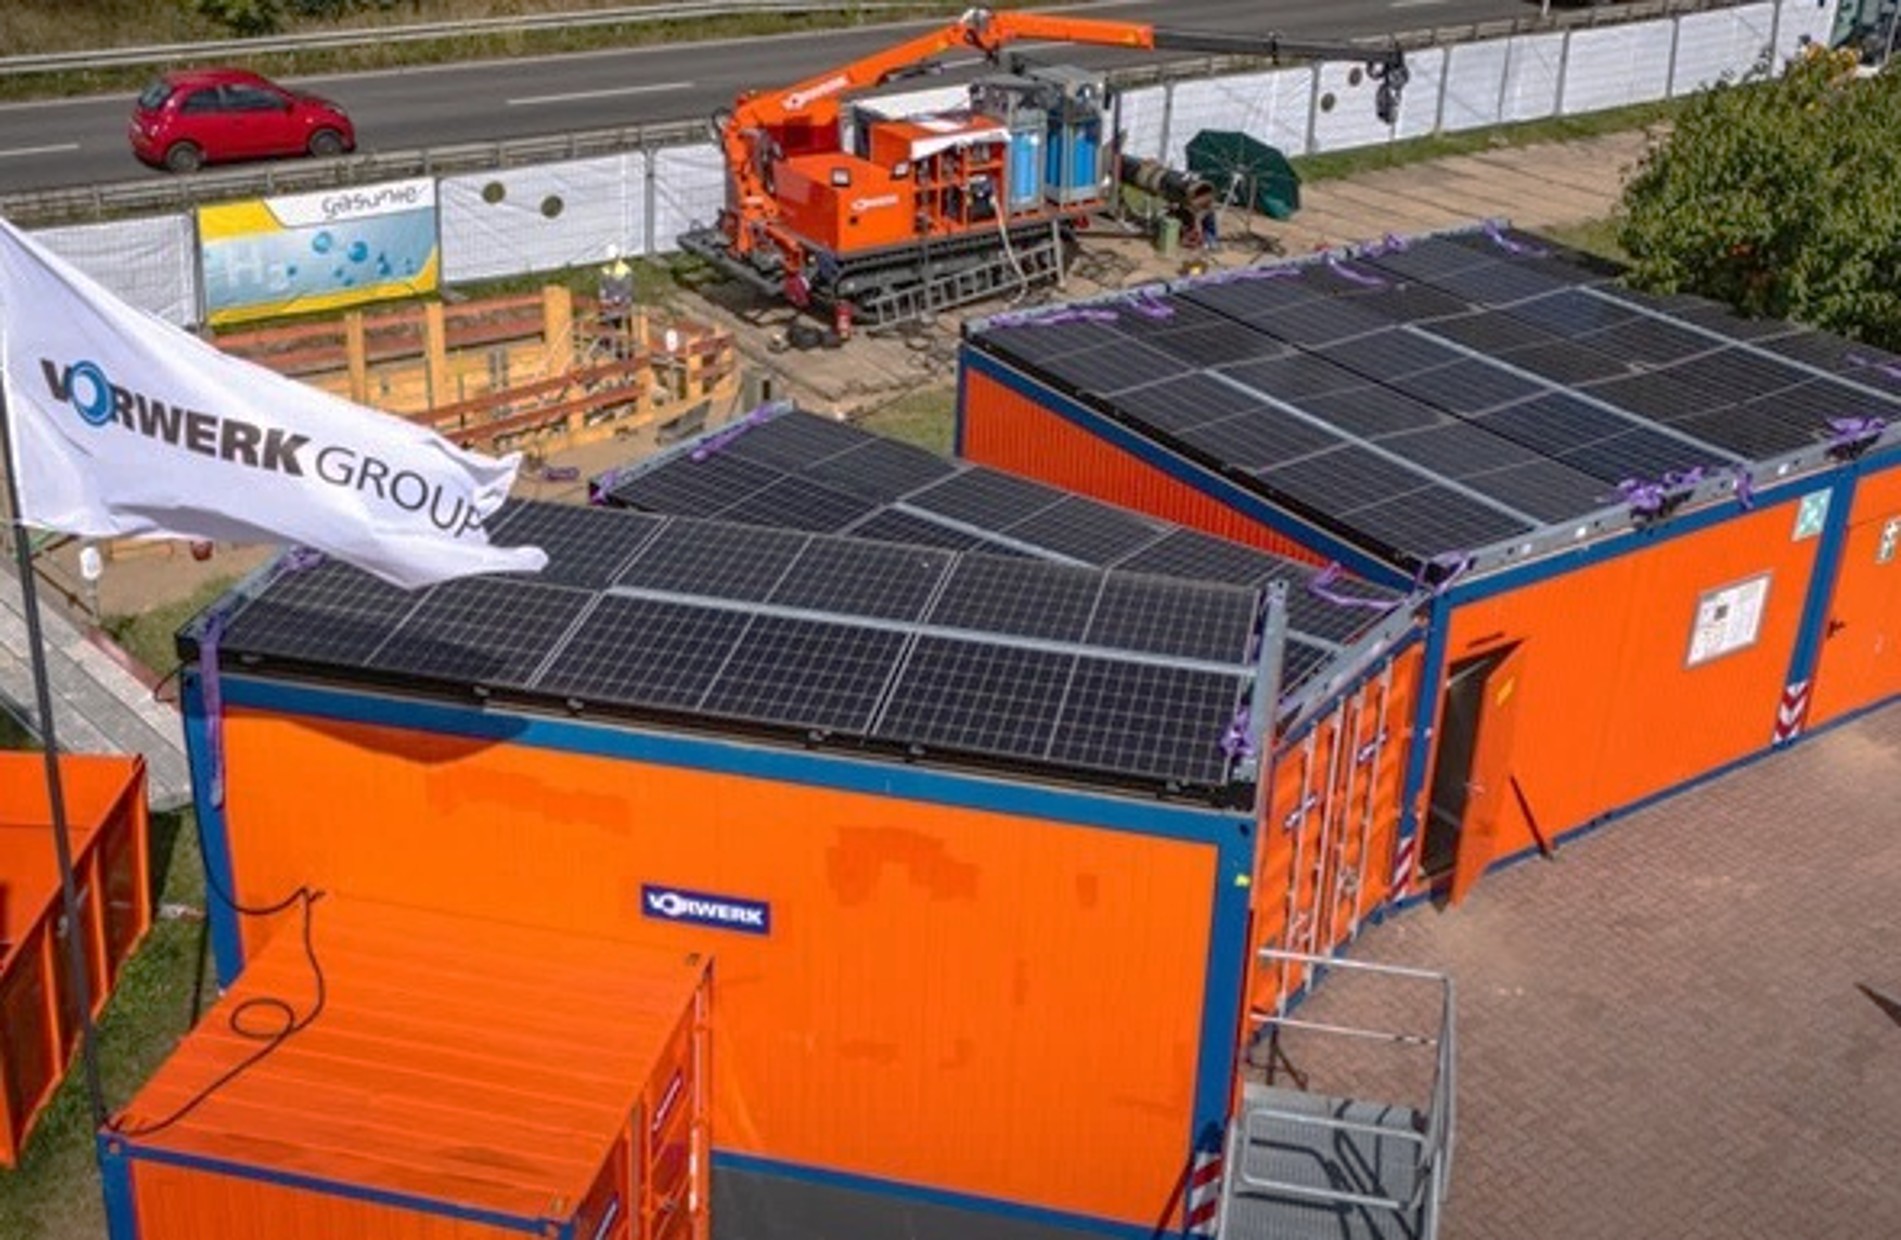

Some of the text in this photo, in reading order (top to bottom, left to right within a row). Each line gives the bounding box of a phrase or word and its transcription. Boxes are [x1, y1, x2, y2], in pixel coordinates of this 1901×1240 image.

[41, 358, 484, 538] VORWERK GROUP
[648, 892, 764, 925] VORWERK
